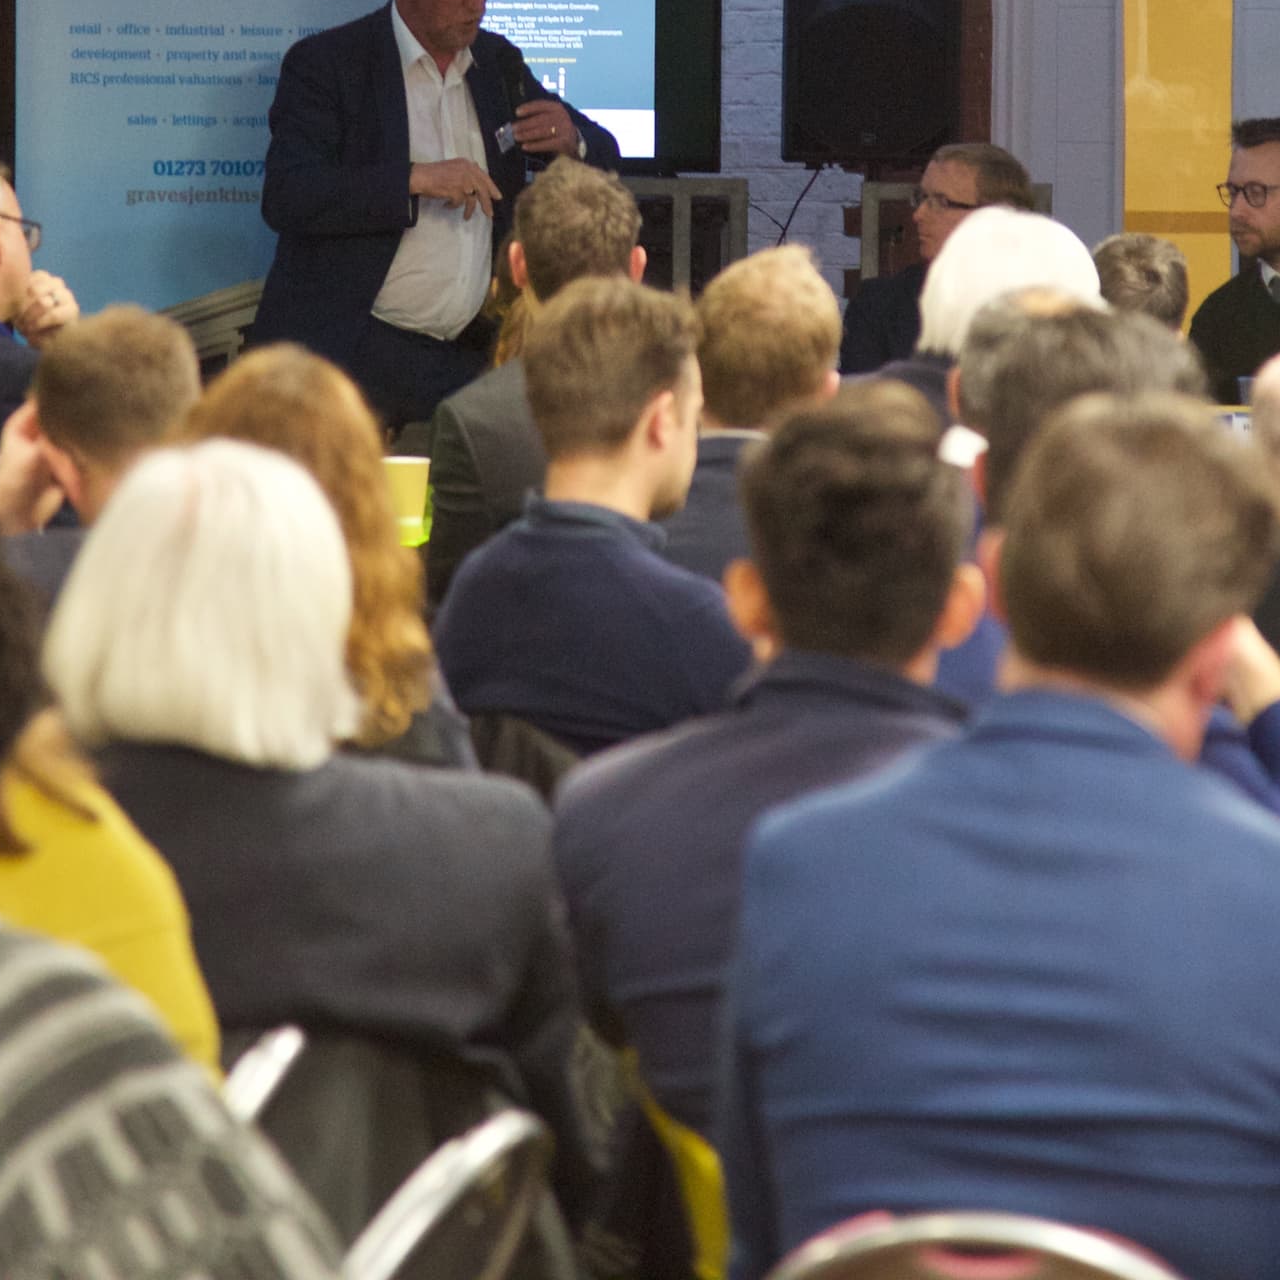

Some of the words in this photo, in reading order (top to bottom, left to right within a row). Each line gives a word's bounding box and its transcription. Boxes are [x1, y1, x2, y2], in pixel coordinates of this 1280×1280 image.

[69, 23, 102, 35] retail
[116, 23, 151, 36] office
[165, 24, 225, 37] industrial
[240, 24, 283, 37] leisure
[71, 47, 152, 63] development
[166, 49, 219, 64] property
[222, 48, 247, 61] and
[70, 72, 101, 86] RICS
[103, 72, 176, 88] professional
[179, 73, 243, 87] valuations
[127, 114, 158, 126] sales
[172, 114, 218, 128] lettings
[153, 159, 207, 177] 01273
[211, 159, 267, 177] 70107
[125, 187, 260, 206] gravesjenkins
